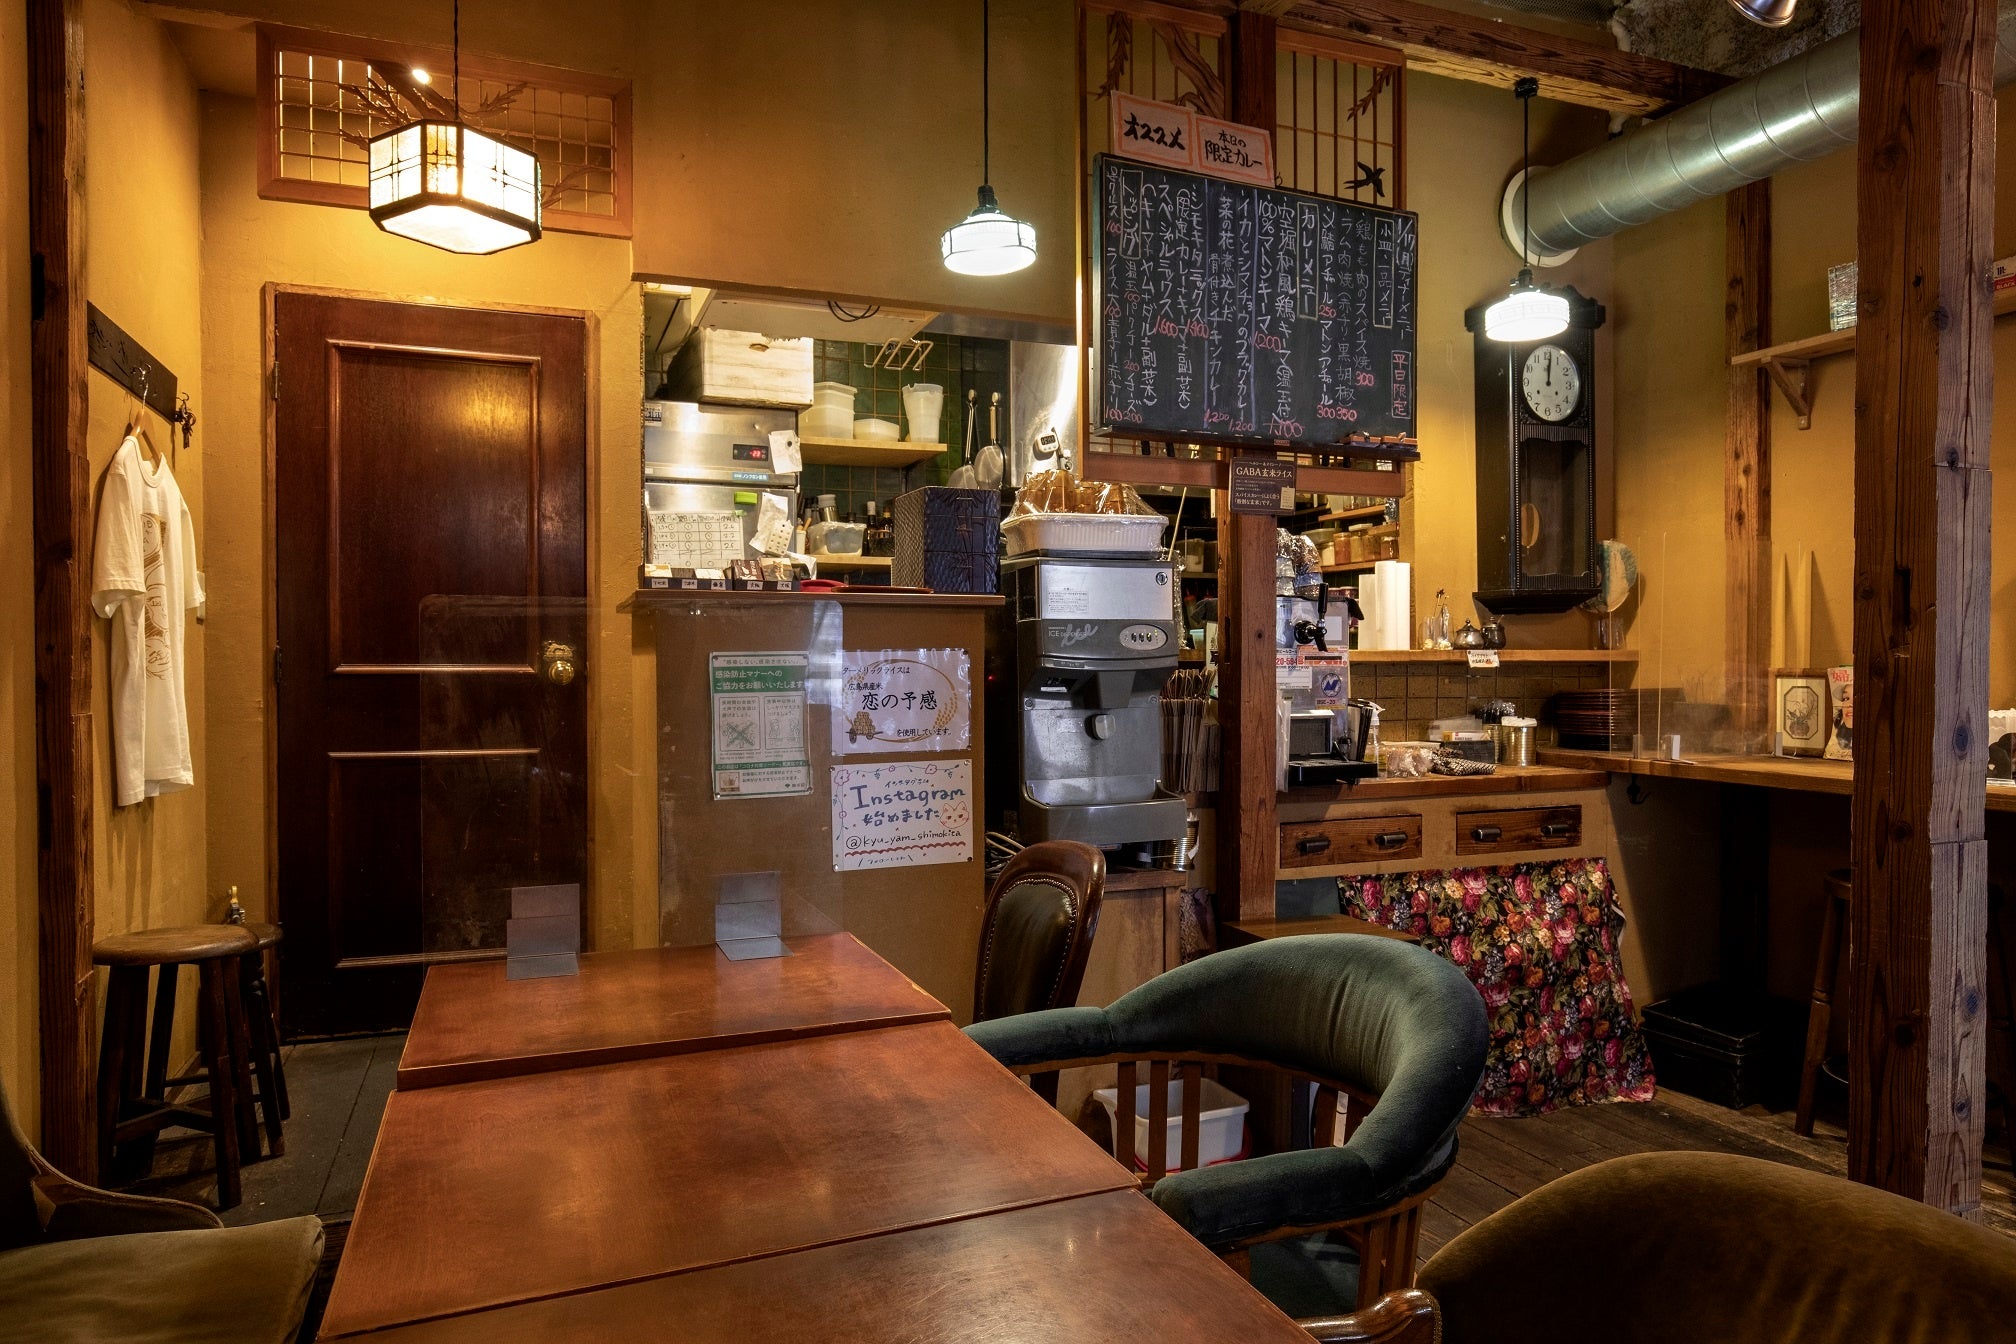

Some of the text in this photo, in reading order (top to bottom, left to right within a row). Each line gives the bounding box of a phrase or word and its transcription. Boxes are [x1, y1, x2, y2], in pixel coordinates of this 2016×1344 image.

[1122, 111, 1186, 152] オススメ
[1218, 131, 1247, 148] 本日の
[1204, 140, 1263, 169] 限定カレー
[1300, 208, 1316, 314] カレーメニュー
[1318, 304, 1337, 319] 250
[1356, 371, 1375, 387] 300
[1393, 353, 1409, 416] 平日限定
[1316, 404, 1336, 419] 300
[1336, 406, 1358, 421] 350
[1236, 466, 1293, 478] GABA玄米ライス
[716, 669, 788, 681] 感染防止マナーへの
[842, 665, 911, 676] ターメリックライスは
[716, 680, 804, 691] ご協力をお願いいたします
[861, 690, 938, 712] 恋の予感
[896, 728, 953, 739] を使用しています。
[849, 779, 967, 811] Instagram
[862, 802, 940, 828] 始めました
[845, 824, 962, 846] @kyu_yam_shimokita
